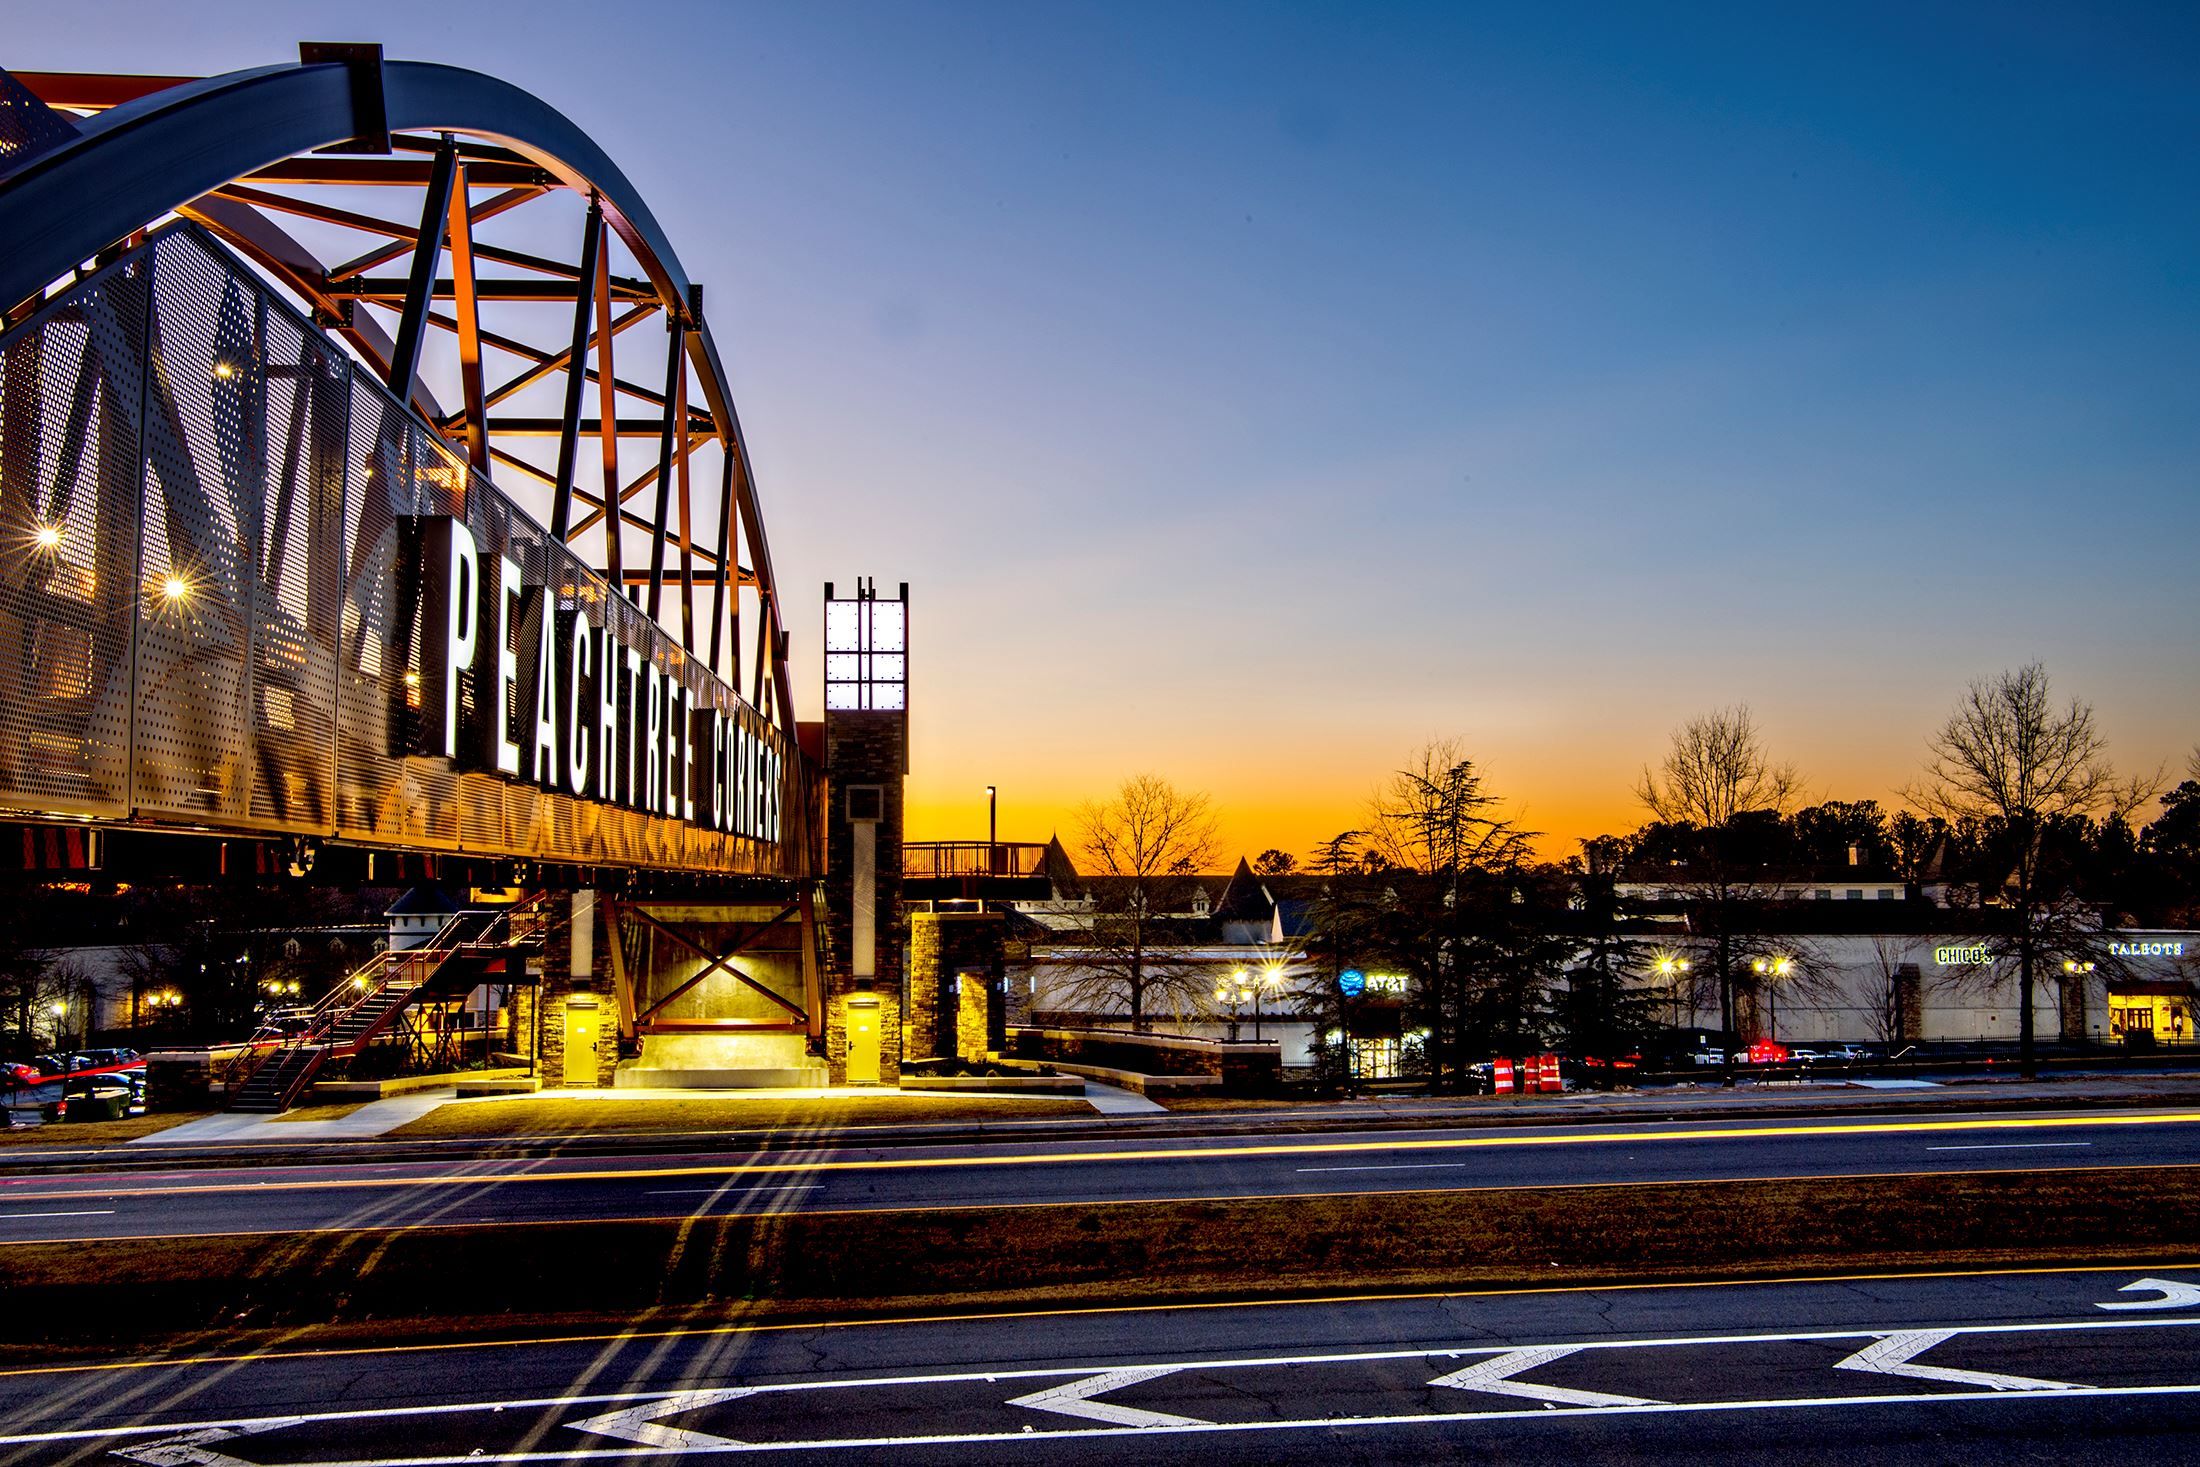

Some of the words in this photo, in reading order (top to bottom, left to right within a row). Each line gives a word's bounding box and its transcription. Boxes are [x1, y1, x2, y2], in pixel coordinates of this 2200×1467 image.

[445, 517, 694, 820] PEACHTREE
[713, 708, 781, 844] CORNERS
[1937, 942, 1994, 965] CHICO'S
[2108, 943, 2184, 955] TALBOTS
[1365, 974, 1409, 992] AT&T
